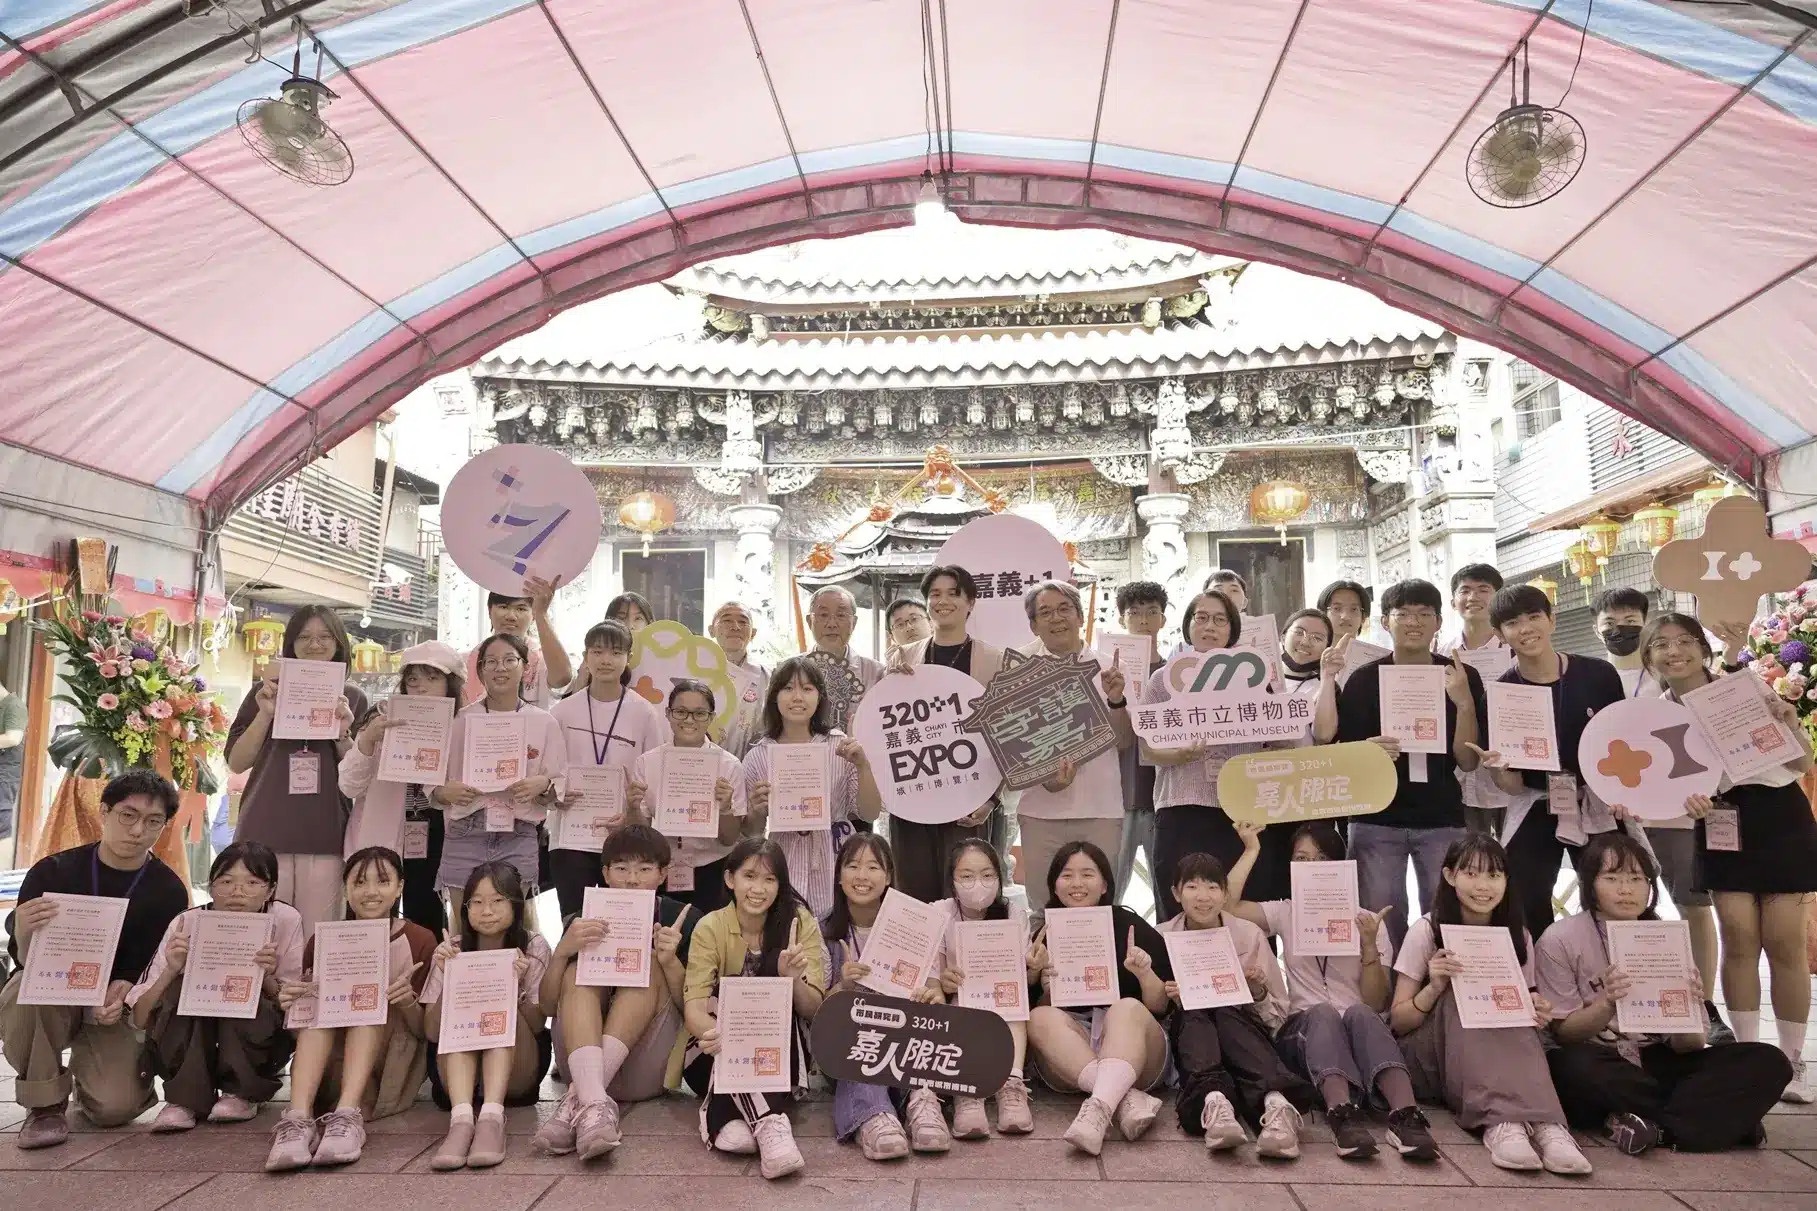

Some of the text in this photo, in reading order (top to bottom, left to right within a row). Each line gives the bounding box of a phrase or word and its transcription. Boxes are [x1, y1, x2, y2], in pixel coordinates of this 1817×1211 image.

[1137, 698, 1309, 731] 嘉義市立博物館
[885, 727, 922, 749] 嘉義
[1152, 725, 1300, 744] CHIAYI MUNICIPAL MUSEUM
[889, 739, 978, 783] EXPO
[1300, 758, 1333, 771] 320+1
[911, 1016, 950, 1033] 320+1
[847, 1029, 963, 1081] 嘉人限定
